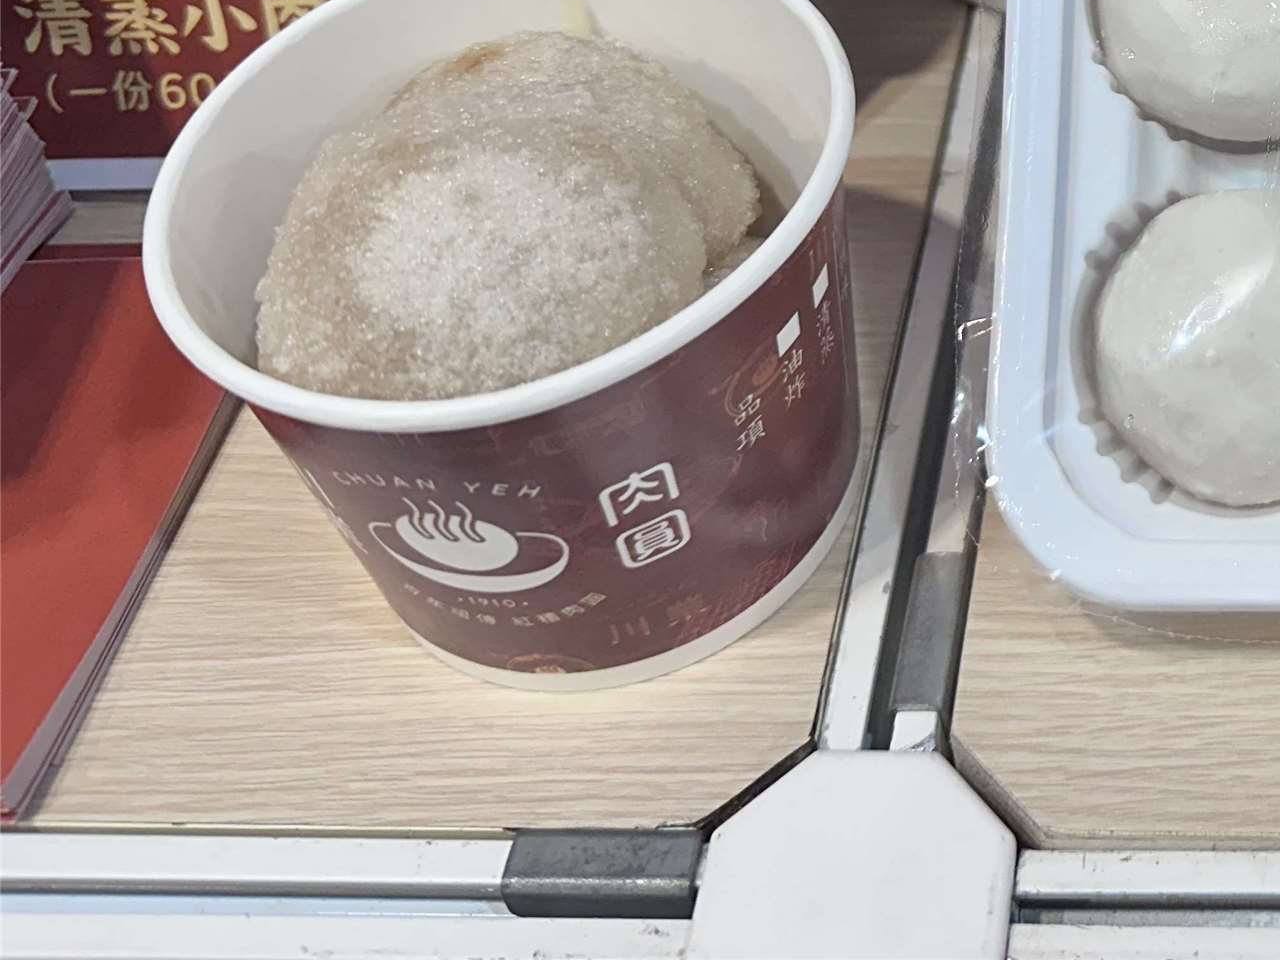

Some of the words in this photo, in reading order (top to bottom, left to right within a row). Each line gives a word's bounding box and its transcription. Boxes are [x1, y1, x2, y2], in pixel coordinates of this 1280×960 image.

[734, 393, 767, 451] 品項
[332, 470, 436, 491] CHUAN
[463, 481, 542, 498] YEH
[599, 461, 691, 569] 肉圓
